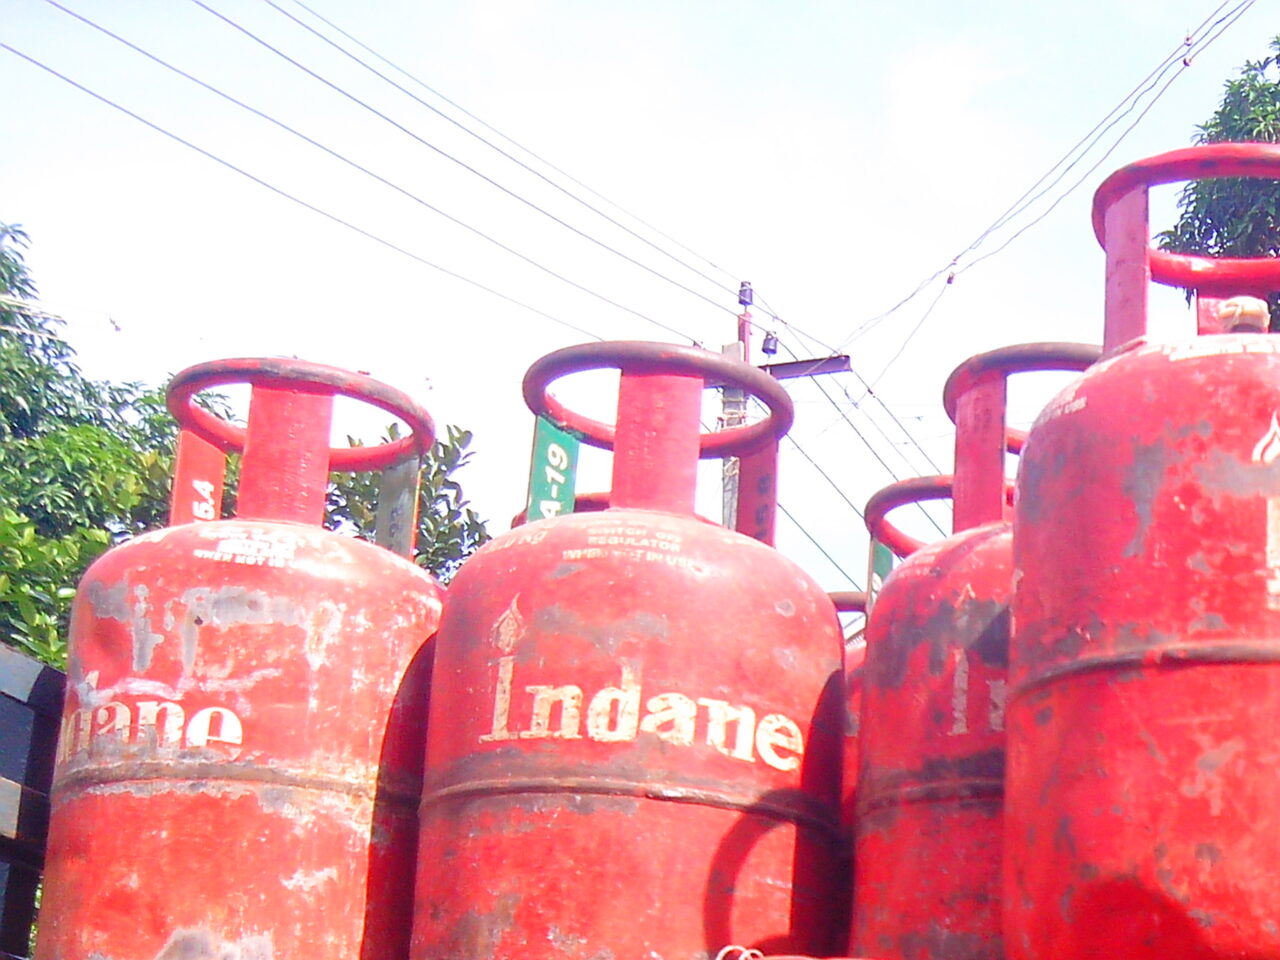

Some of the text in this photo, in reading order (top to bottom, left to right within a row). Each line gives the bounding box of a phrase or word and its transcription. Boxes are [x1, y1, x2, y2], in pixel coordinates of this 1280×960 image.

[192, 479, 215, 523] 5.4
[541, 442, 567, 519] A-19
[58, 668, 244, 763] dane
[478, 655, 804, 773] Indane
